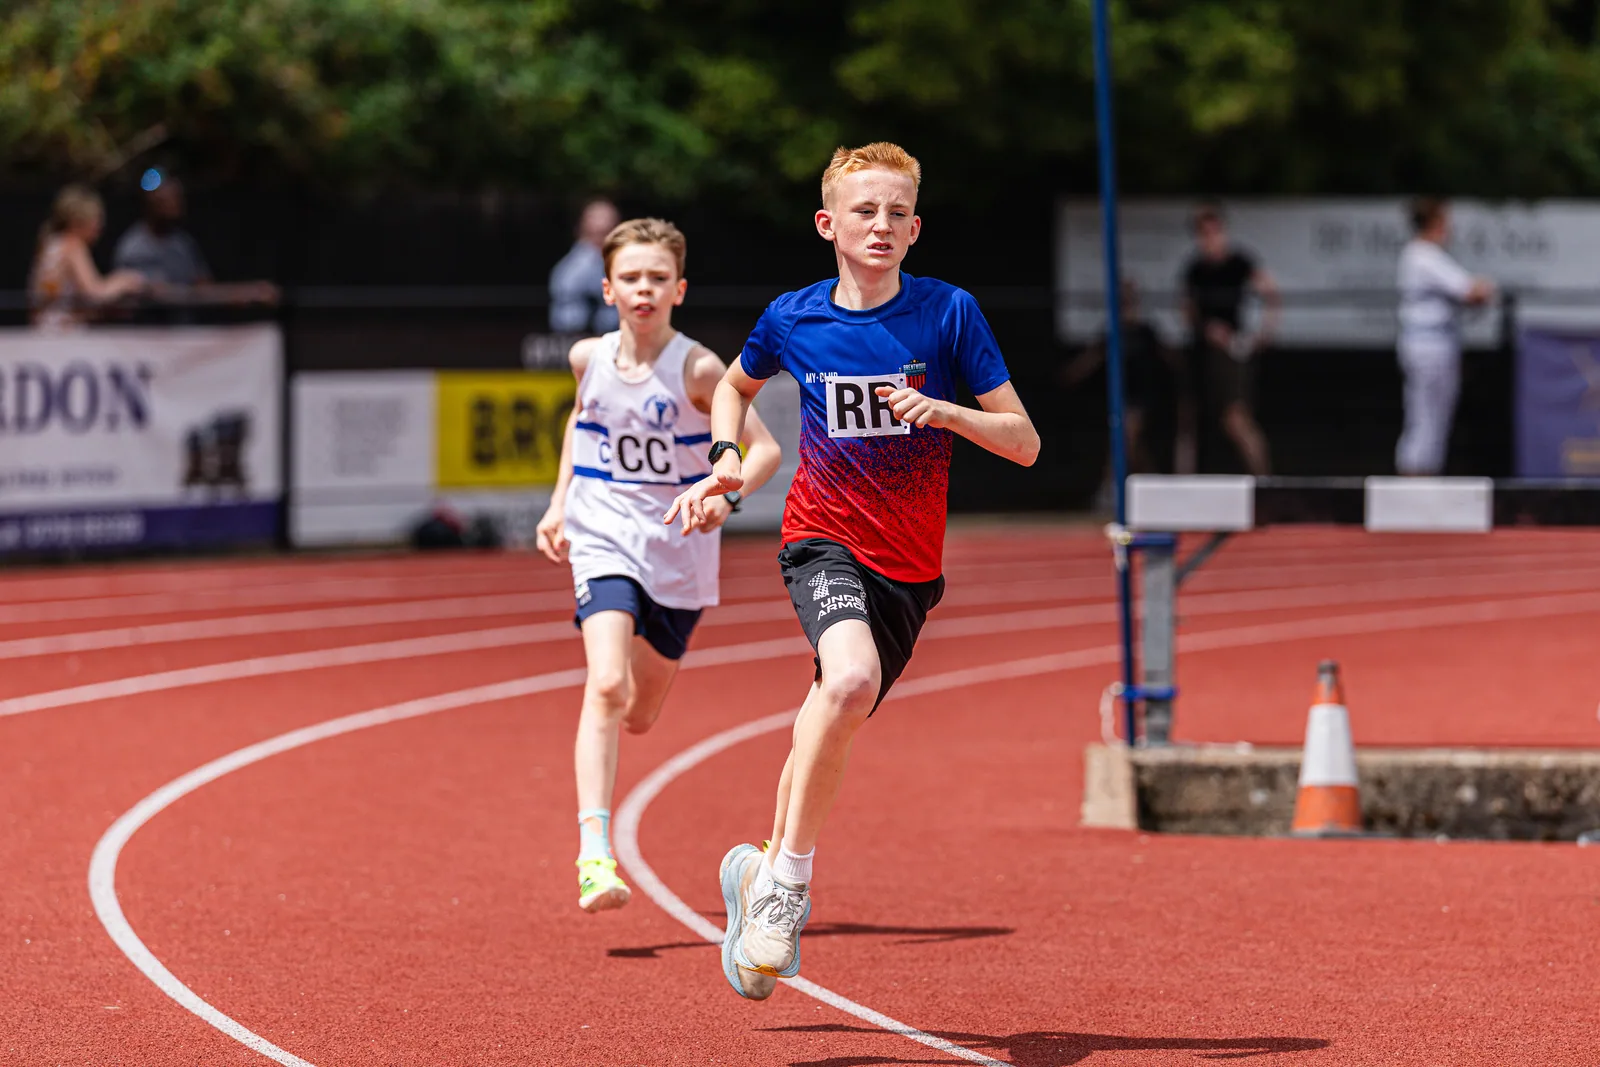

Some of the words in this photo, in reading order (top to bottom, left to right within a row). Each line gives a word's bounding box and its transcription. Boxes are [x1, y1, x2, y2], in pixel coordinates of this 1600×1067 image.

[0, 361, 152, 434] DON
[835, 381, 902, 430] RR
[617, 435, 671, 475] CC
[820, 594, 865, 609] UNDE
